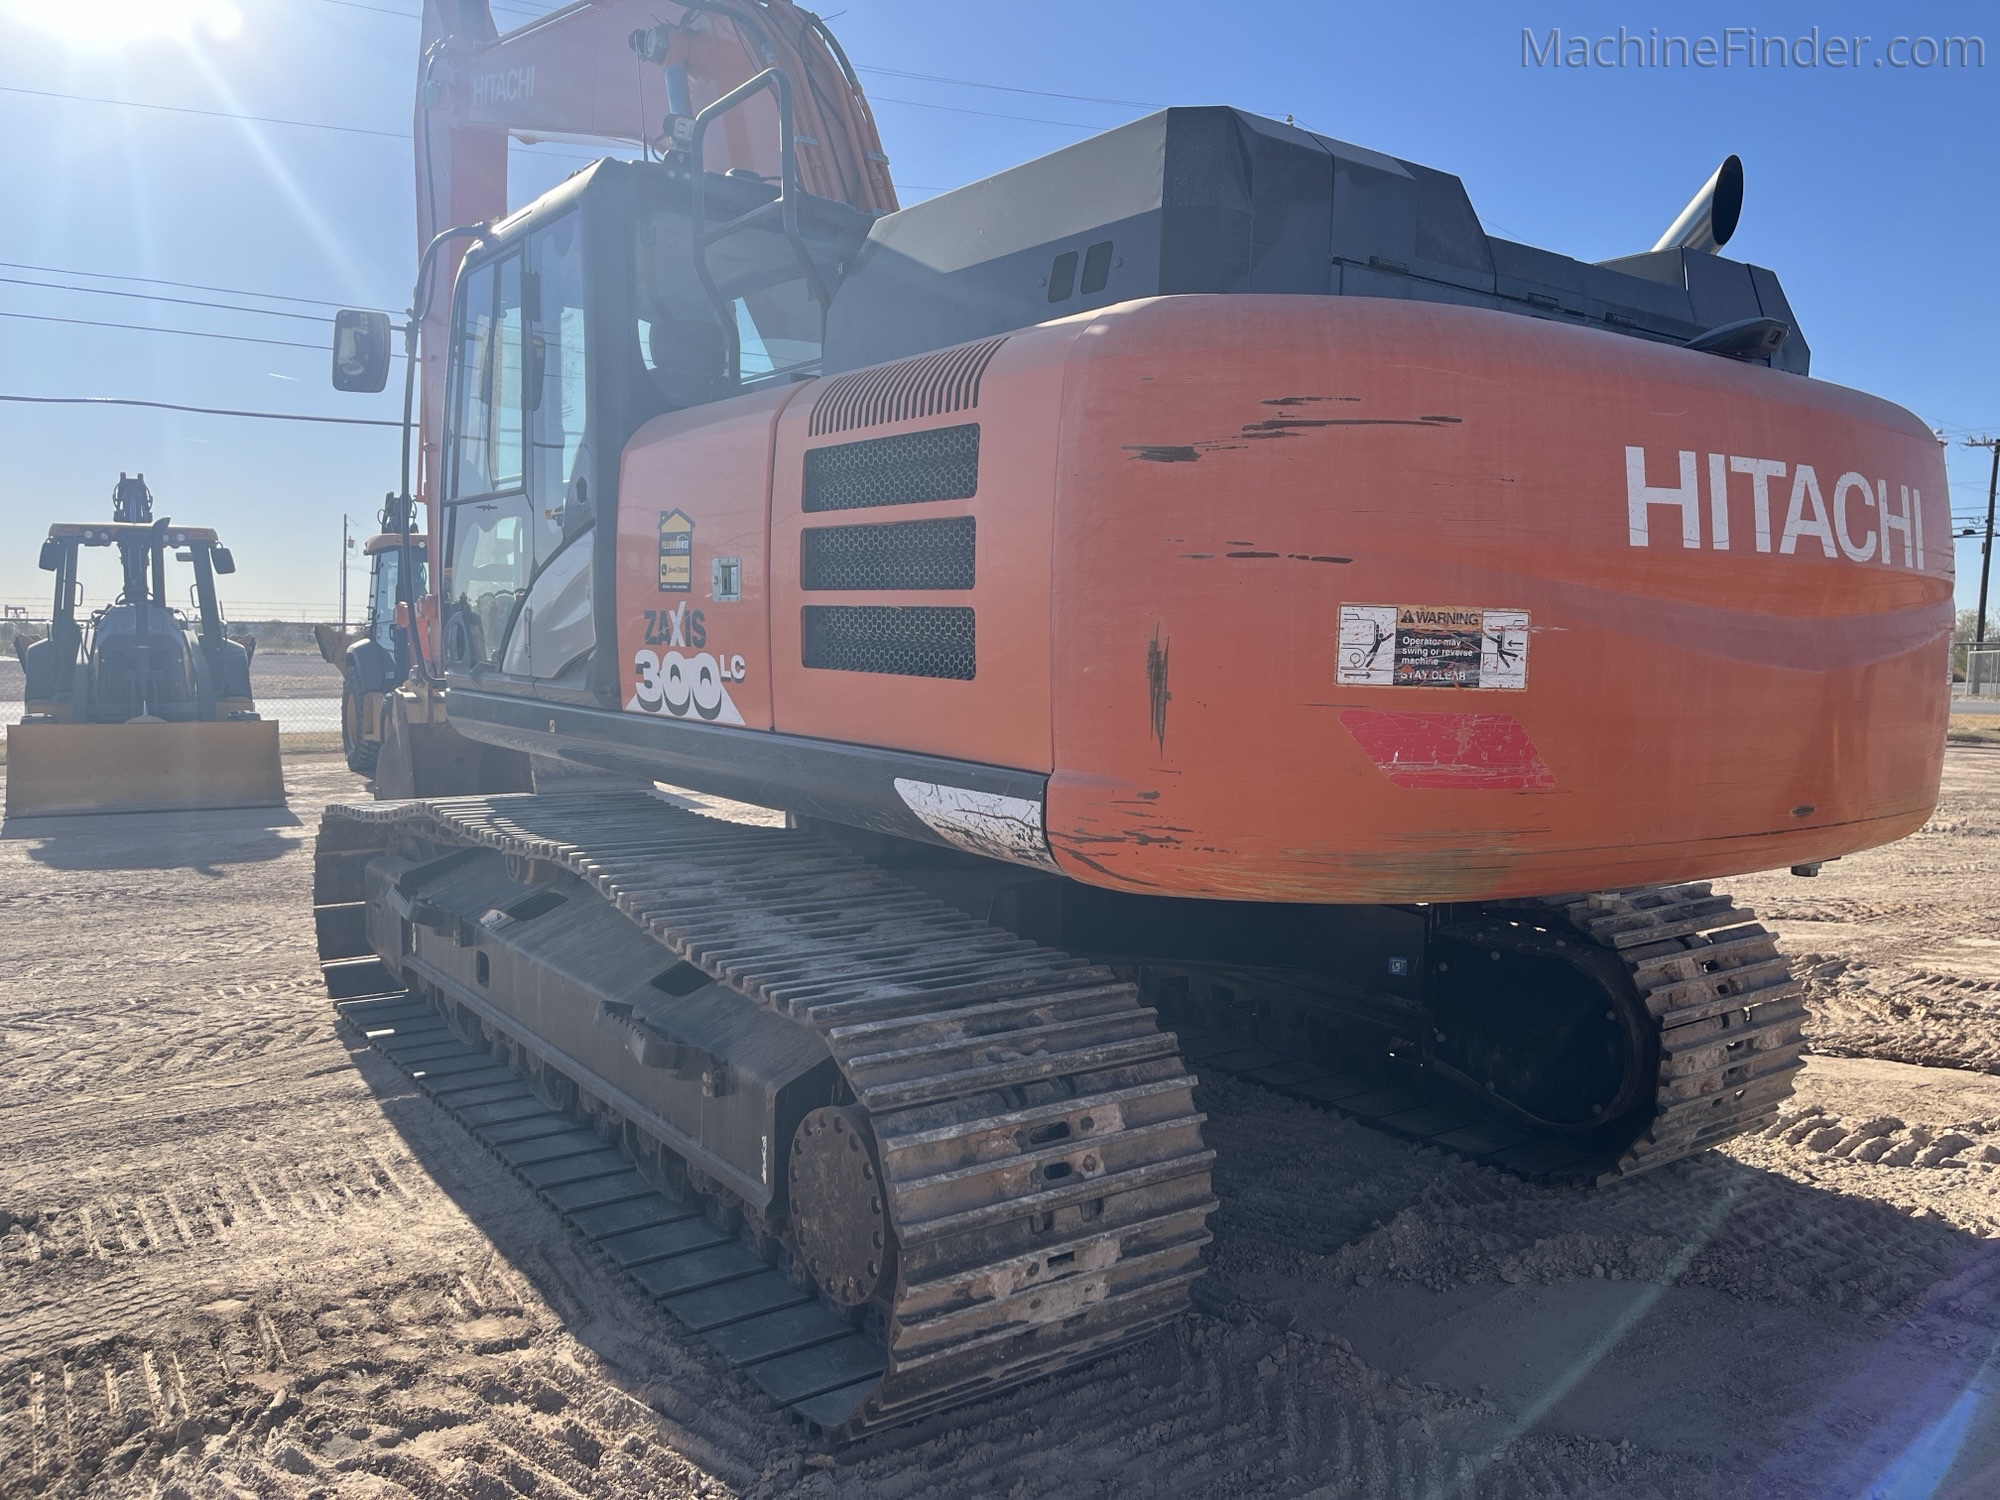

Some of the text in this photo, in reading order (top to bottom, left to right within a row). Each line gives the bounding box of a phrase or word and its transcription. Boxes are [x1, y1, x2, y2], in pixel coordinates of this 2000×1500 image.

[473, 65, 536, 106] HITACHI
[1625, 446, 1925, 570] HITACHI
[644, 601, 707, 648] ZAXIS
[1416, 611, 1479, 625] WARNING
[1401, 657, 1439, 665] machine
[1402, 648, 1429, 656] swing
[634, 650, 722, 720] 300
